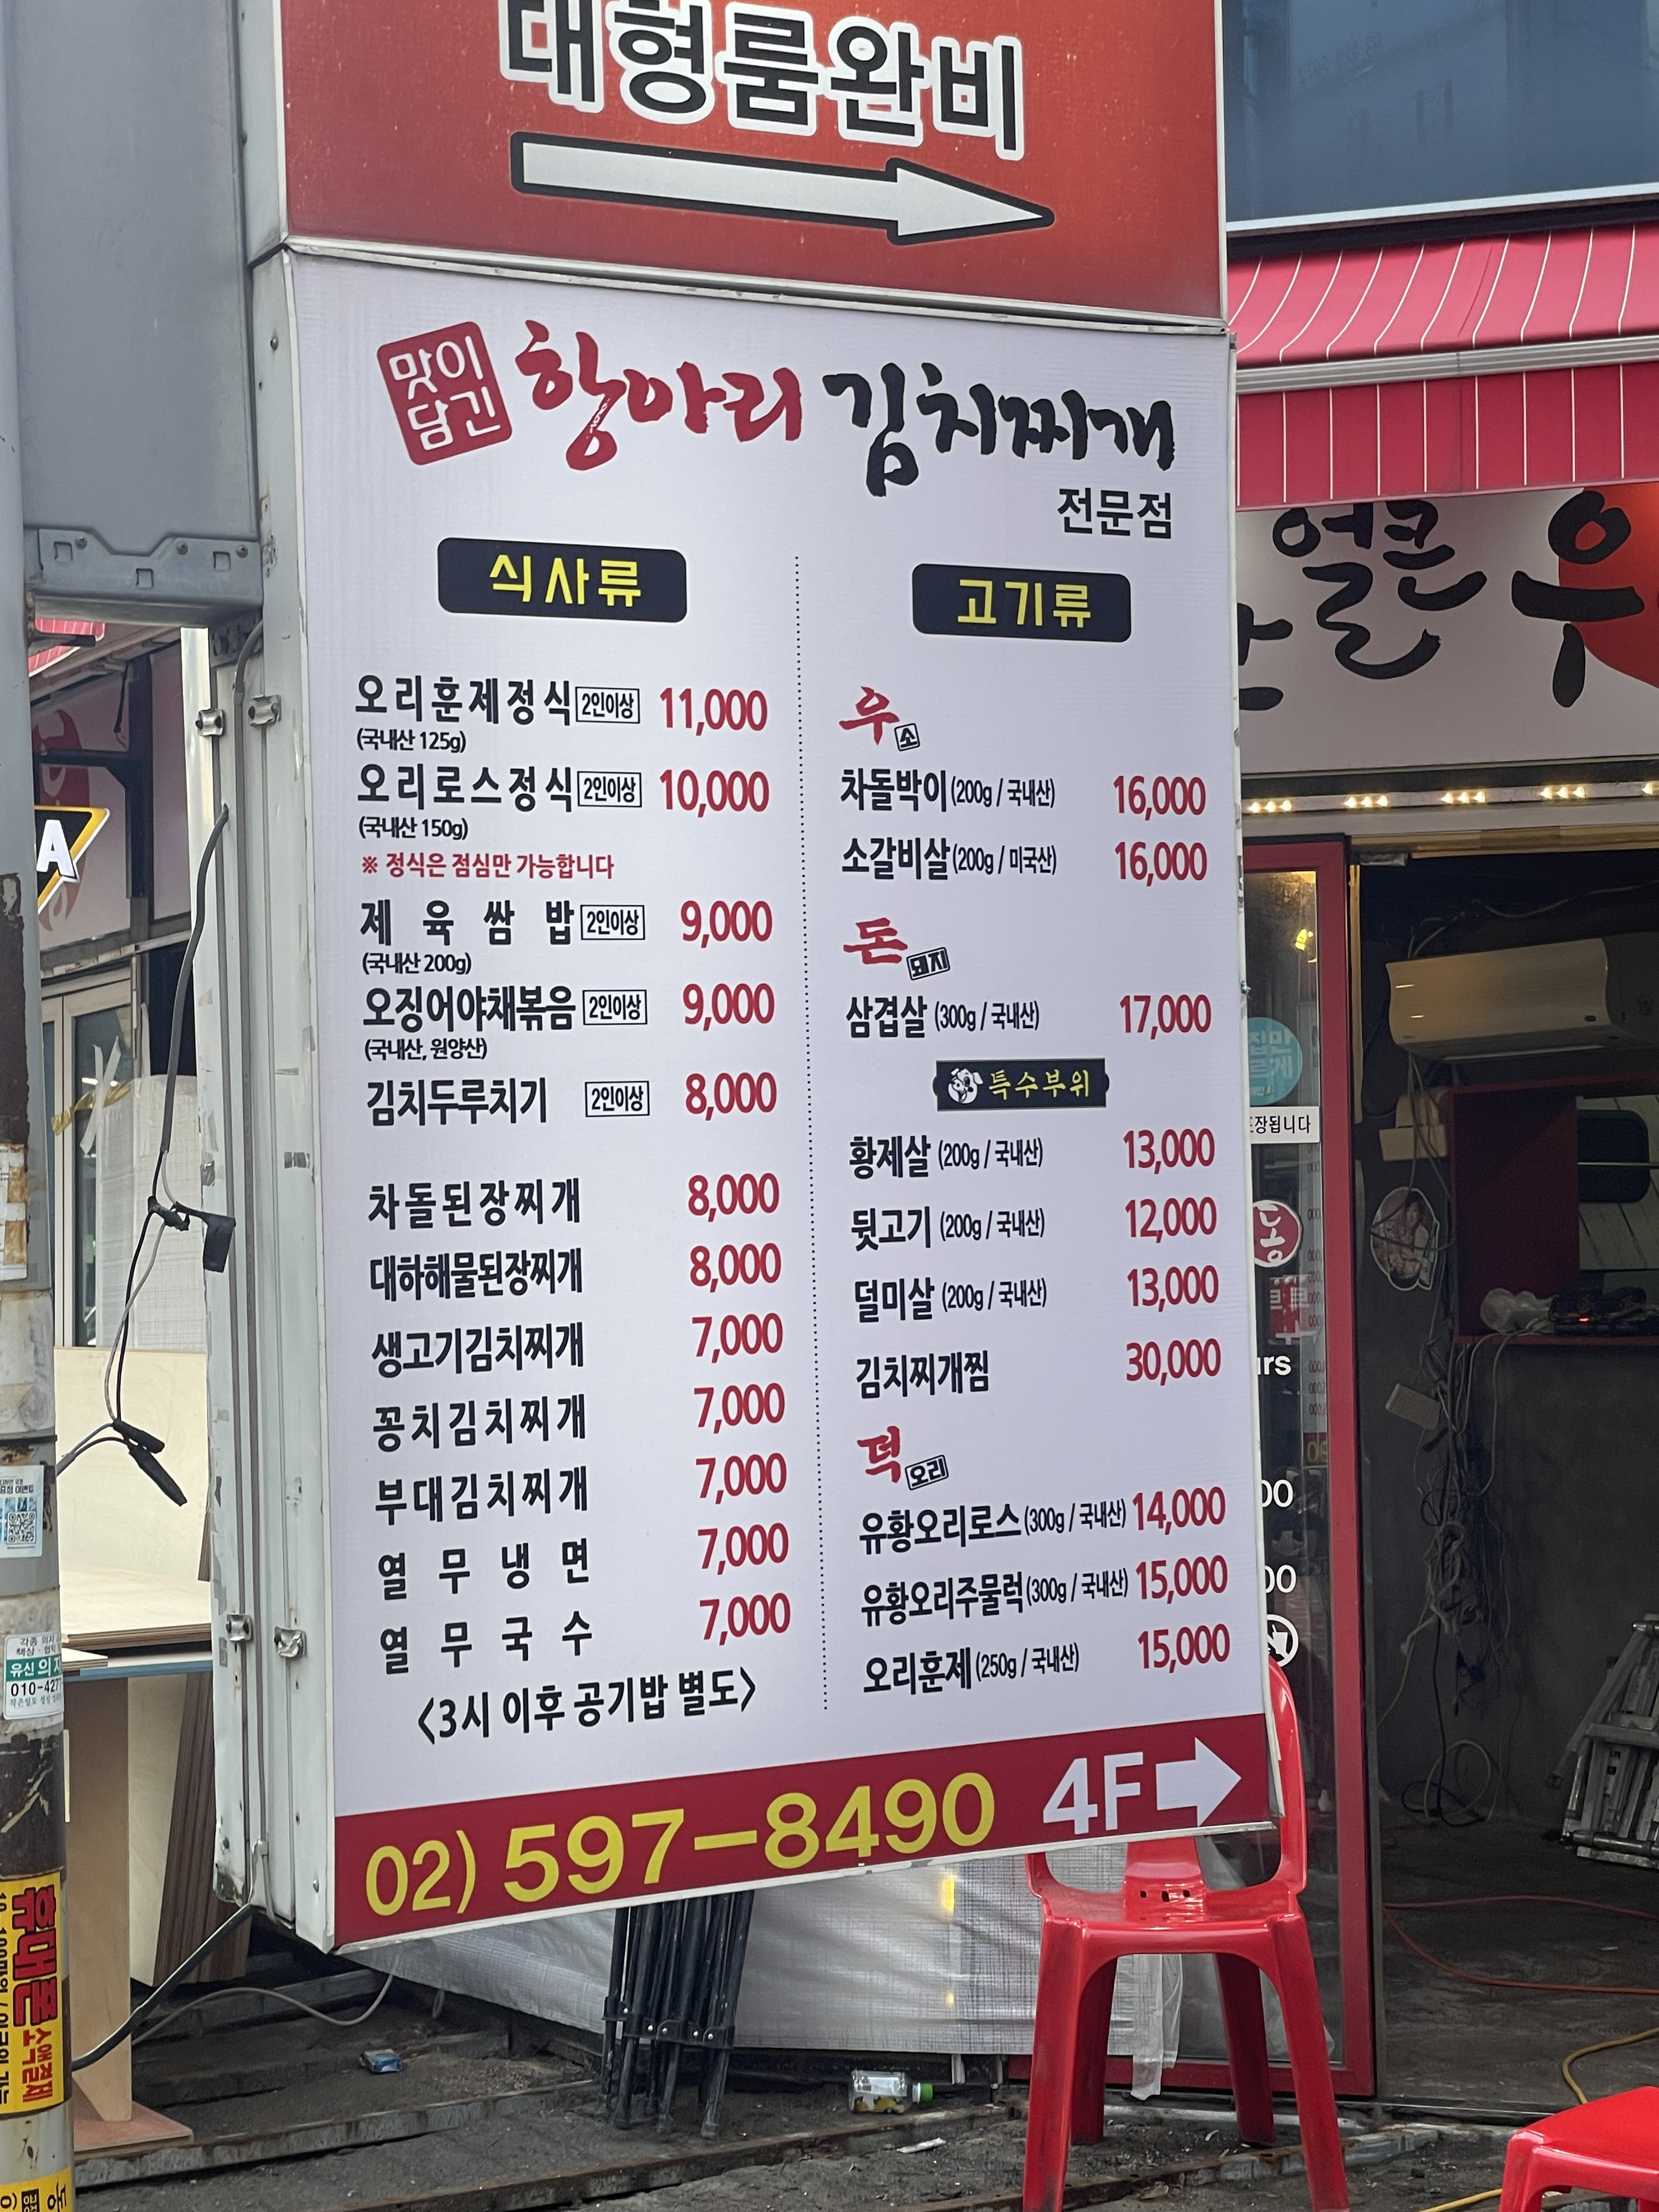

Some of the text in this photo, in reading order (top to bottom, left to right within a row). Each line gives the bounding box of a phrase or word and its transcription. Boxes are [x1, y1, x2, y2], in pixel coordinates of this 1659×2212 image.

[502, 0, 1022, 157] 대형룸완비
[390, 335, 484, 400] 맛이
[408, 386, 500, 451] 담긴
[515, 320, 1175, 496] 항아리 김치찌개
[1057, 487, 1171, 539] 전문점
[489, 554, 641, 607] 식사류
[957, 579, 1091, 628] 고기류
[355, 675, 768, 736] 오리훈제정식 2인이상 11,000
[838, 686, 900, 745] 우
[357, 727, 466, 753] (국내산 125g)
[357, 763, 770, 818] 오리로스정식 2인이상 10,000
[840, 768, 947, 812] 차돌박이
[1113, 775, 1206, 821] 16,000
[359, 816, 469, 840] (국내산 150g)
[386, 852, 447, 878] 정식은
[452, 853, 512, 878] 점심만
[516, 853, 614, 879] 가능합니다
[842, 837, 951, 881] 소갈비살
[1115, 841, 1207, 887] 16,000
[587, 909, 639, 936] 2인이상
[680, 900, 773, 949] 9,000
[843, 917, 908, 964] 돈
[362, 952, 472, 975] (국내산 200g)
[363, 983, 775, 1033] 오징어야채볶음 2인이상 9,000
[846, 995, 928, 1039] 삼겹살
[1120, 994, 1211, 1040] 17,000
[366, 1071, 777, 1126] 김치두루치기 2인이상 8,000
[989, 1069, 1089, 1101] 특수부위
[849, 1135, 932, 1180] 황제살
[1123, 1128, 1215, 1175] 13,000
[368, 1172, 780, 1231] 차돌된장찌개 8,000
[851, 1206, 931, 1252] 뒷고기
[1125, 1197, 1217, 1244] 12,000
[370, 1243, 782, 1302] 대하해물된장찌개 8,000
[855, 1277, 935, 1323] 덜미살
[1127, 1265, 1219, 1312] 13,000
[371, 1312, 783, 1379] 생고기김치찌개 7,000
[856, 1338, 1221, 1399] 김치찌개찜 30,000
[373, 1383, 785, 1453] 꽁치김치찌개 7,000
[375, 1452, 787, 1526] 부대김치찌개 7,000
[909, 1459, 946, 1487] 오리
[859, 1503, 1022, 1555] 유황오리로스
[1132, 1486, 1226, 1536] 14,000
[697, 1522, 789, 1576] 7,000
[861, 1571, 1023, 1627] 유황오리주물럭
[1135, 1555, 1228, 1604] 15,000
[699, 1593, 791, 1646] 7,000
[864, 1647, 972, 1695] 오리훈제
[1138, 1623, 1230, 1674] 15,000
[503, 1685, 565, 1734] 이후
[574, 1674, 668, 1727] 공기밥
[366, 1830, 476, 1917] 02)
[1043, 1751, 1144, 1835] 4F
[12, 1884, 57, 2027] 휴대폰
[22, 2028, 53, 2102] 소액결제
